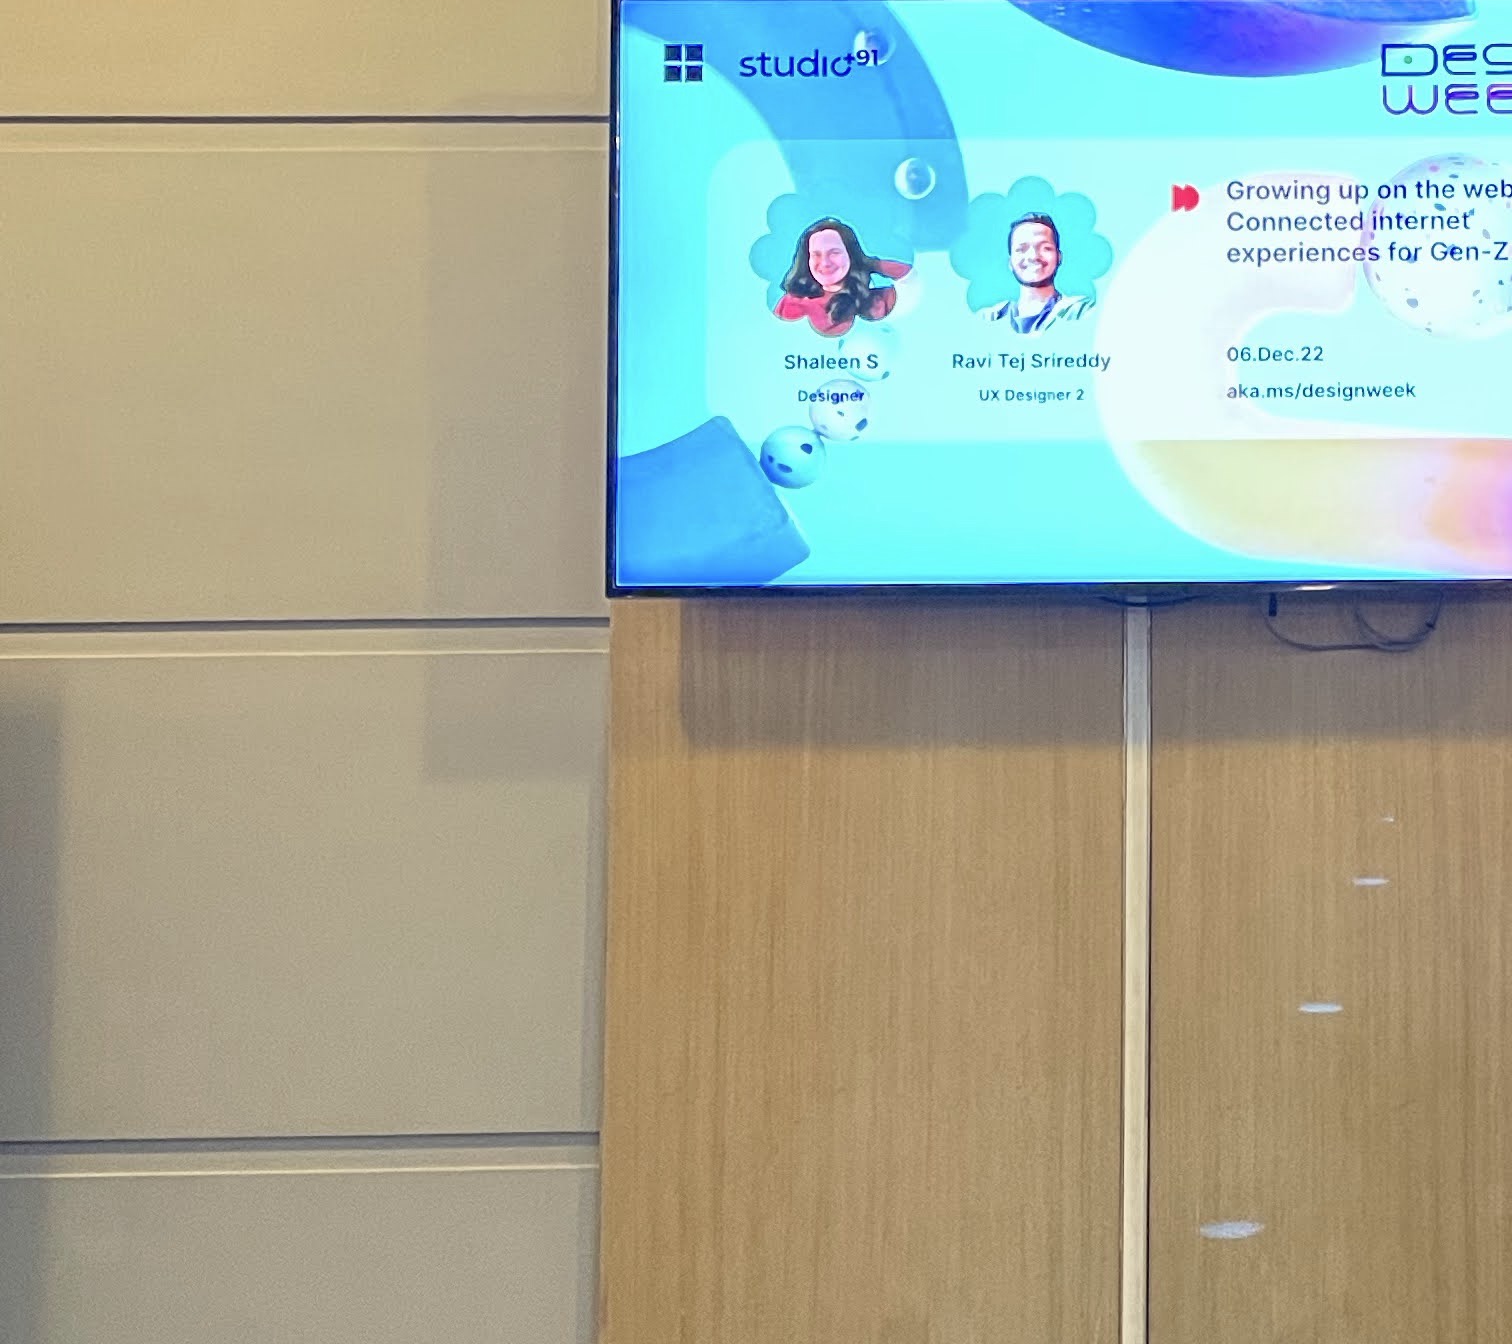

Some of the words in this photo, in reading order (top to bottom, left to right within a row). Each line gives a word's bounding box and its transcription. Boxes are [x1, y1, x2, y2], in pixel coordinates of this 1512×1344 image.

[1226, 180, 1331, 206] Growing
[1339, 180, 1369, 206] up
[1377, 180, 1408, 202] on
[1415, 180, 1455, 202] the
[1226, 211, 1364, 233] Connected
[1373, 210, 1471, 232] internet
[1226, 241, 1380, 268] experiences
[1387, 242, 1422, 263] for
[1430, 240, 1509, 263] Gen-Z
[784, 353, 861, 371] Shaleen
[865, 354, 879, 371] S
[952, 353, 992, 370] Ravi
[997, 353, 1026, 373] Tej
[1031, 353, 1112, 373] Srireddy
[1226, 345, 1324, 363] 06.Dec.22
[797, 389, 865, 405] Designer
[979, 389, 1000, 403] UX
[1004, 388, 1071, 405] Designer
[1076, 389, 1085, 403] 2
[1226, 380, 1417, 402] aka.ms/designweek
